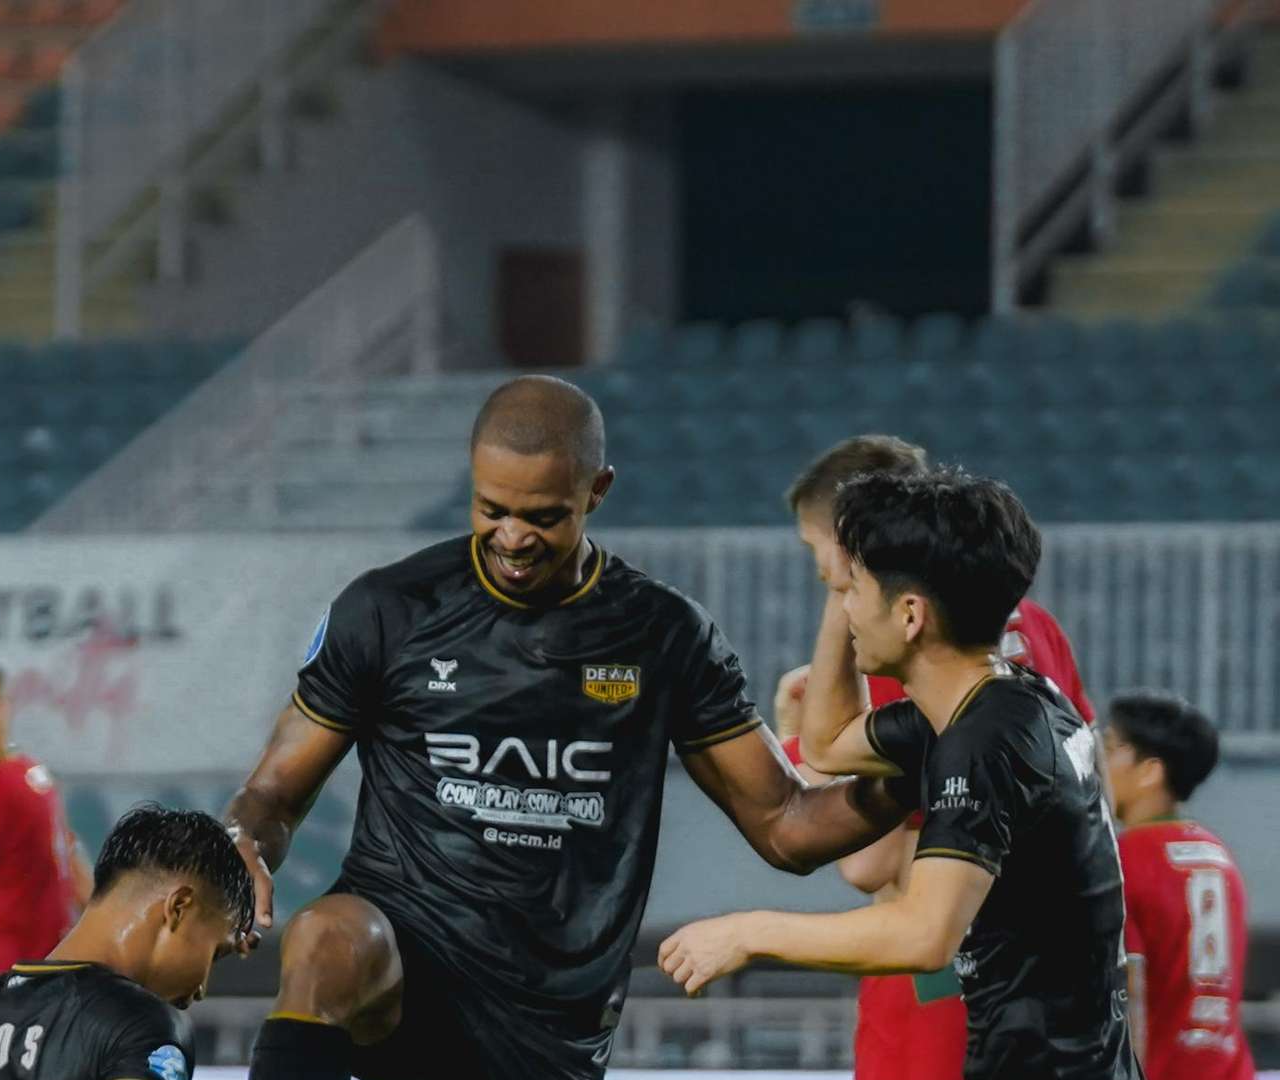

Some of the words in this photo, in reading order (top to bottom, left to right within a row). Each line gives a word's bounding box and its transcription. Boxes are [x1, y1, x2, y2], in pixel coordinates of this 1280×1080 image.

[427, 680, 457, 692] DRX
[585, 667, 635, 681] DEWA
[424, 732, 614, 782] BAIC
[942, 776, 969, 795] JHL
[441, 782, 478, 807] COW
[485, 787, 520, 810] PLAY
[527, 793, 560, 814] COW
[568, 797, 599, 820] MOO
[483, 827, 562, 850] @cpcm.id
[1185, 869, 1231, 980] 8
[20, 1024, 45, 1071] S
